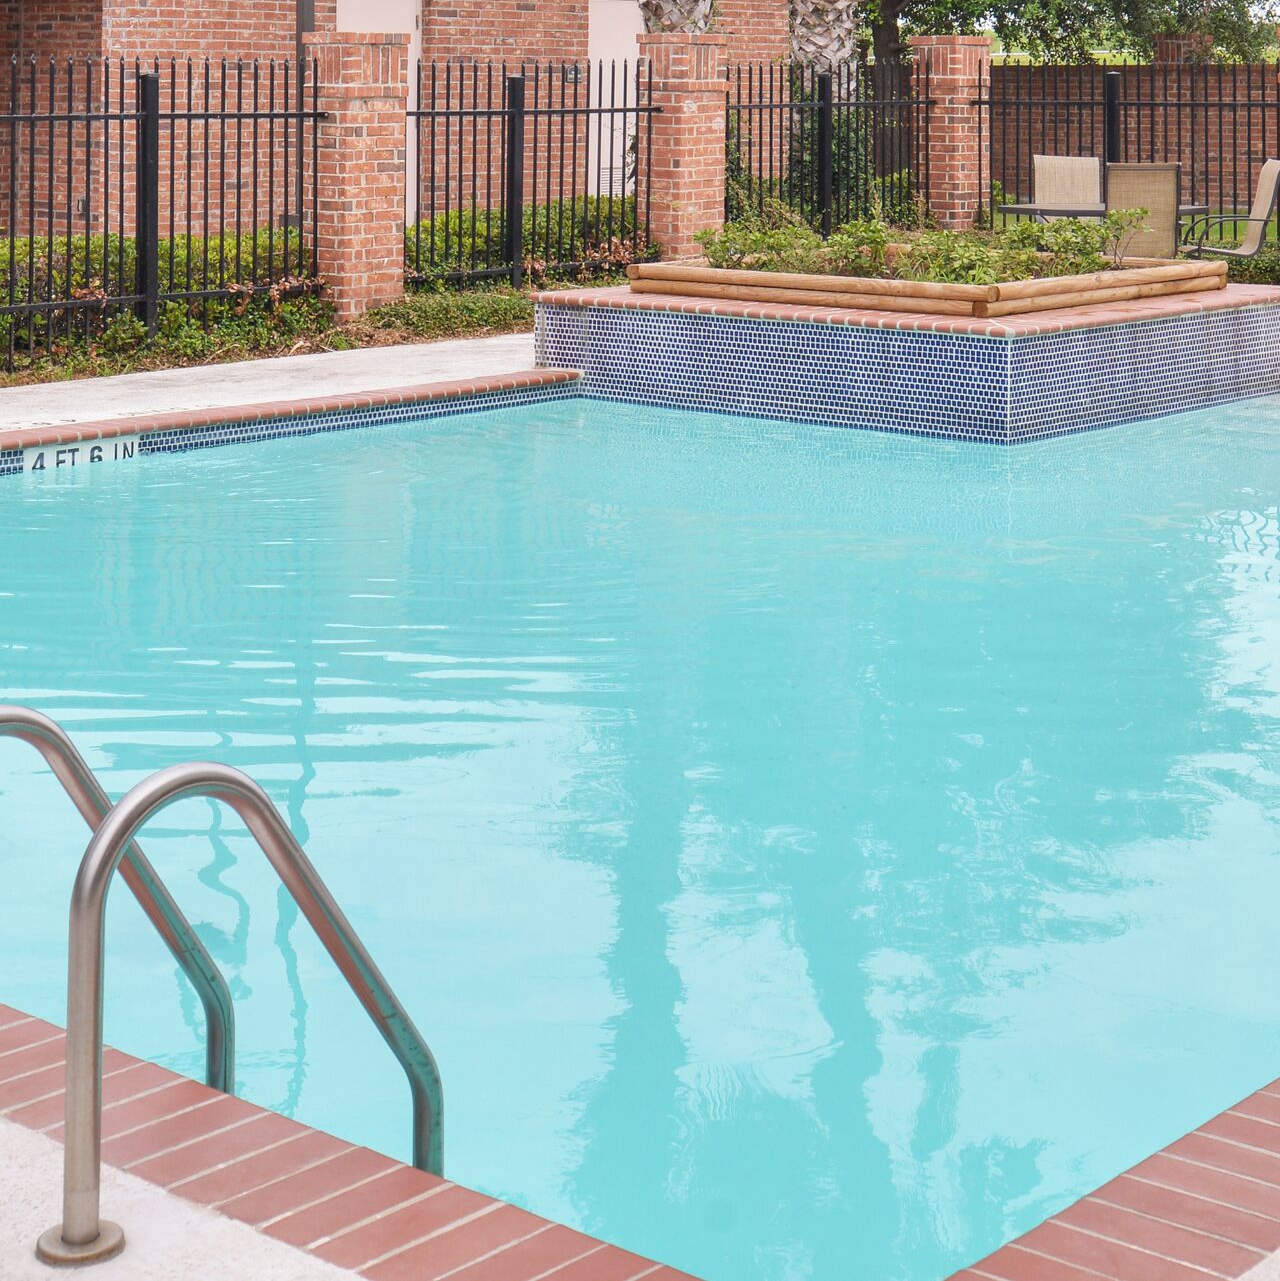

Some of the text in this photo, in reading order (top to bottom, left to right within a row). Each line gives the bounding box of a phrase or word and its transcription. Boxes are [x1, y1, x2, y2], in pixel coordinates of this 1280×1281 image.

[32, 441, 134, 470] 4 FT 6 IN
